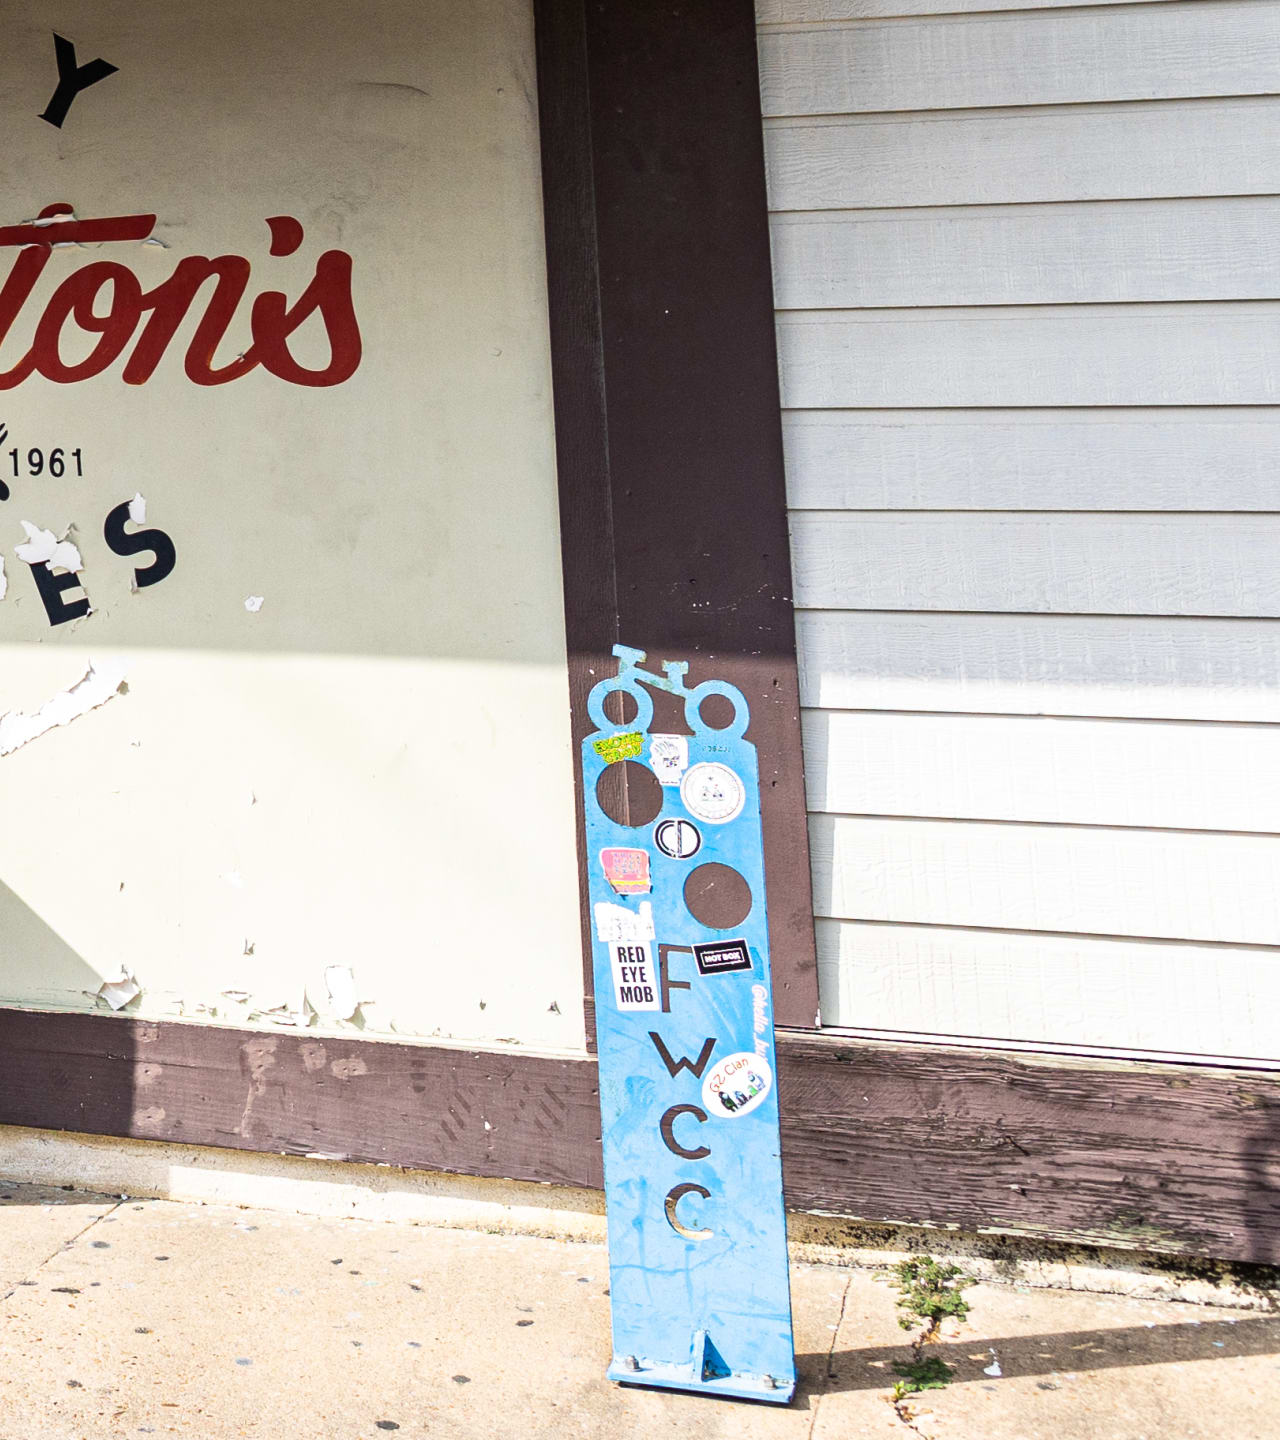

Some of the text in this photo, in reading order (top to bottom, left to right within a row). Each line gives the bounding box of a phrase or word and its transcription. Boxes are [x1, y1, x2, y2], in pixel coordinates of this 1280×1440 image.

[8, 447, 84, 478] 1961
[617, 945, 646, 963] RED
[621, 966, 648, 983] EYE
[619, 986, 654, 1003] MOB
[724, 1058, 749, 1076] Clan
